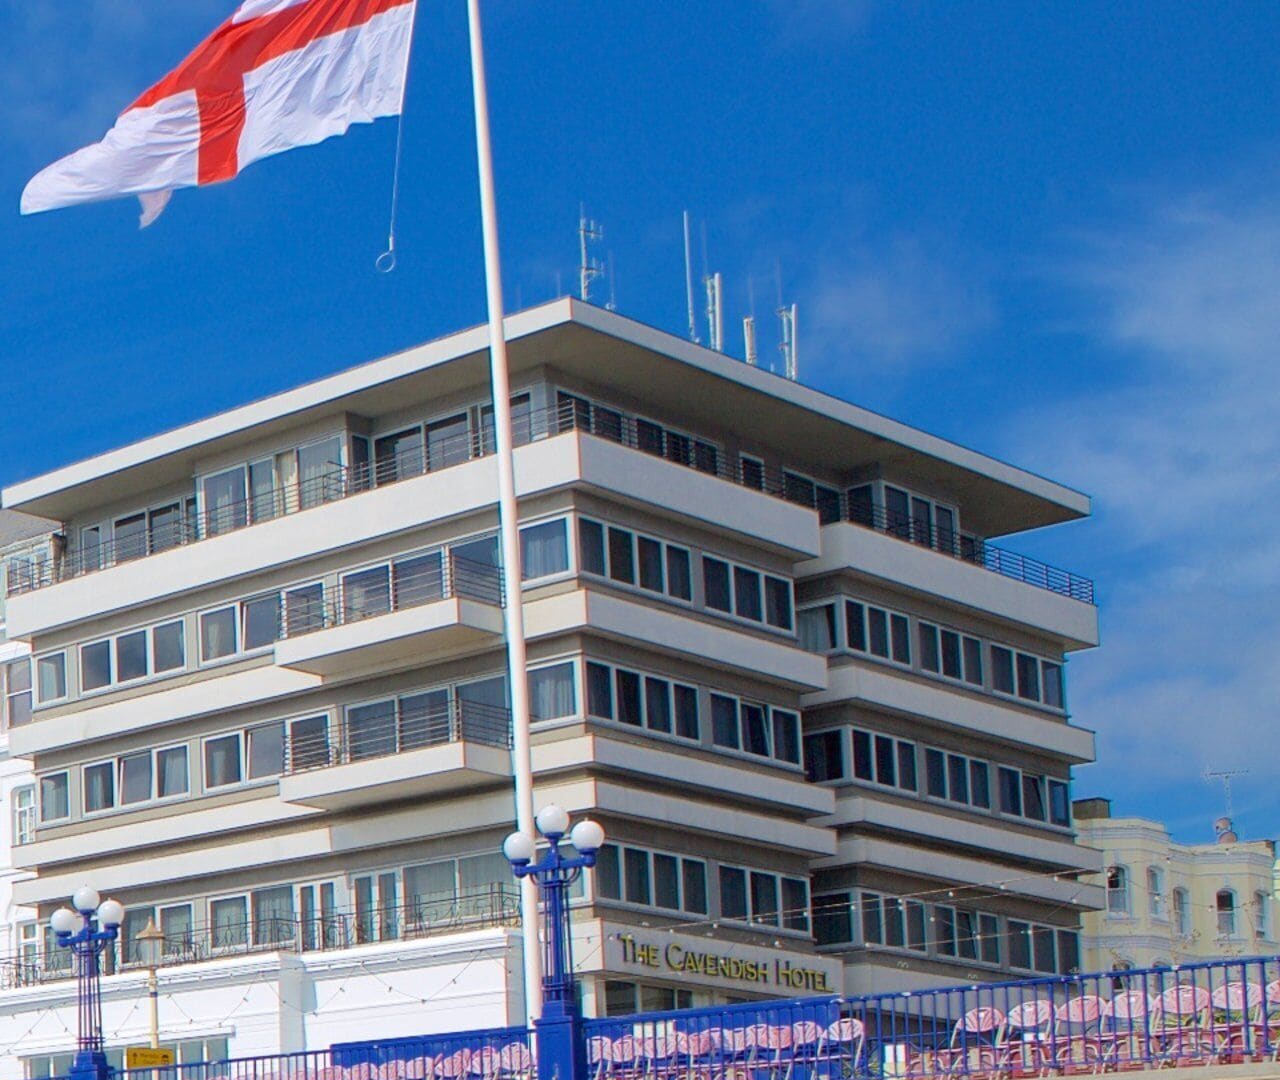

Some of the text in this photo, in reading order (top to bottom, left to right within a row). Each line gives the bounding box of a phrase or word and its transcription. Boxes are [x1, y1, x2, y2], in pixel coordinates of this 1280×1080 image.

[617, 933, 834, 993] THE CAVENDISH HOTEL
